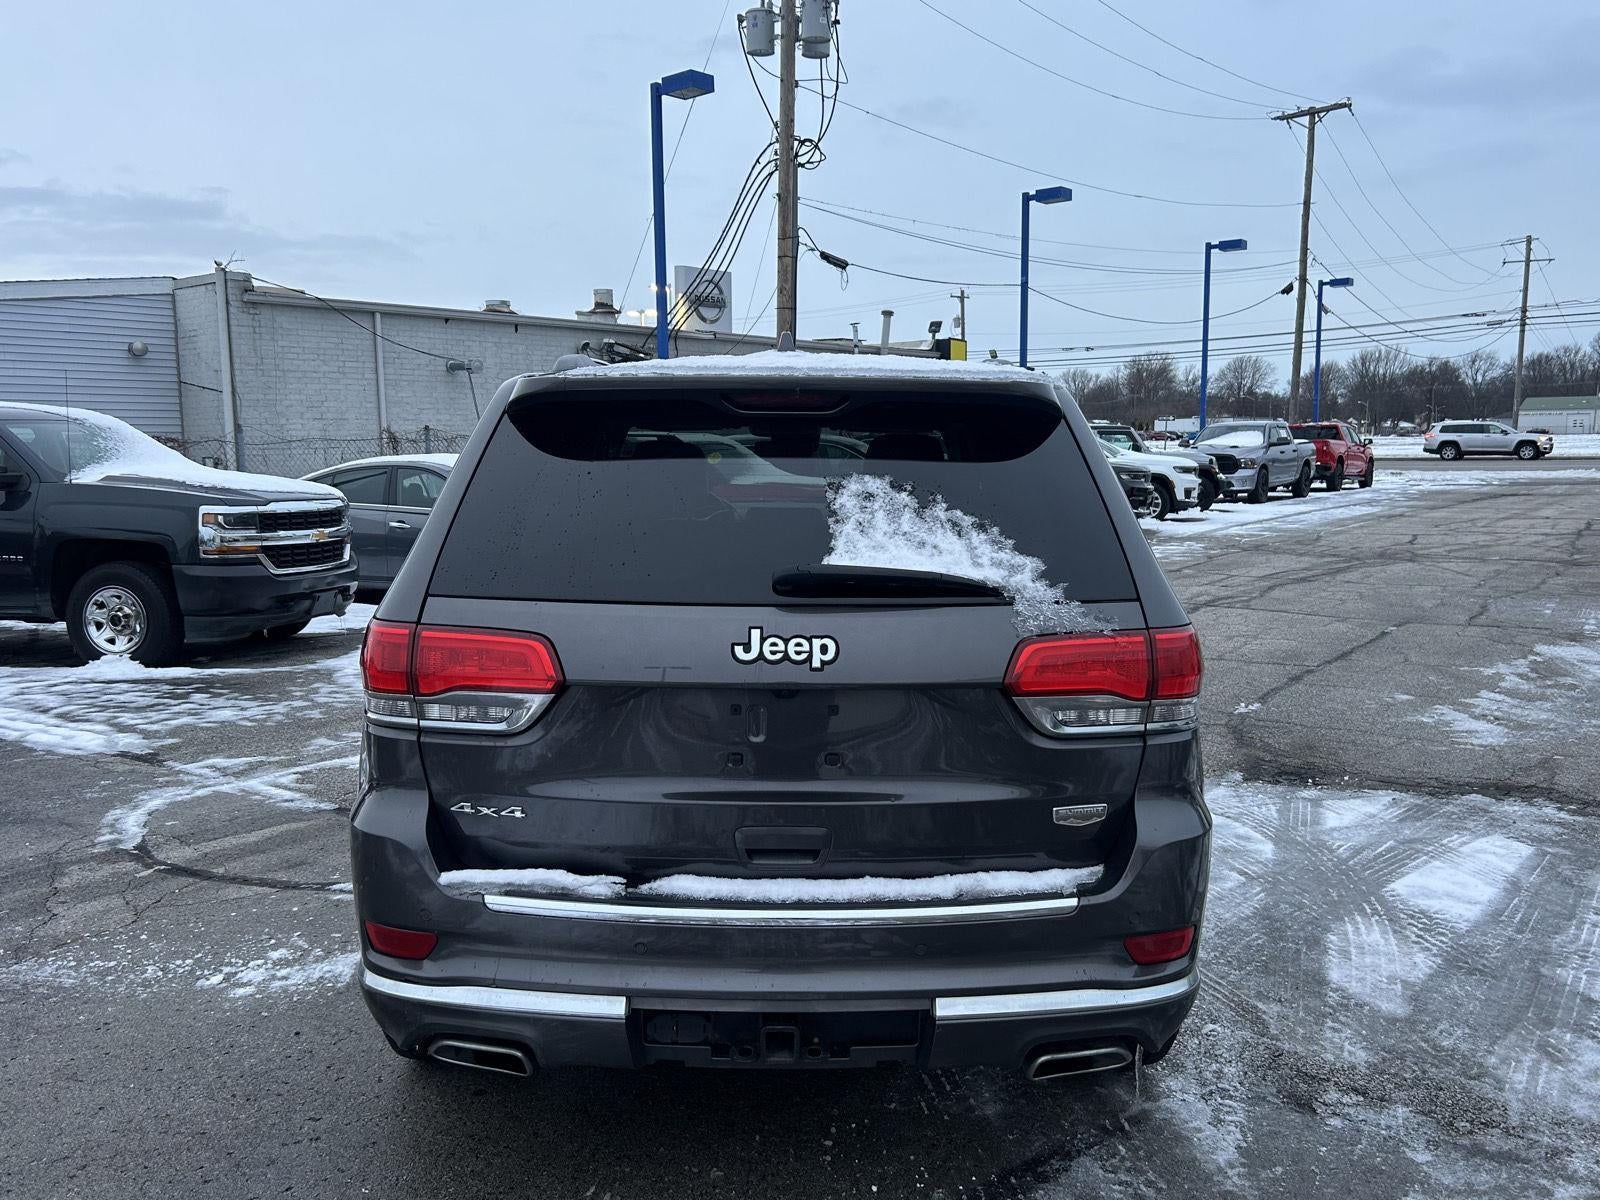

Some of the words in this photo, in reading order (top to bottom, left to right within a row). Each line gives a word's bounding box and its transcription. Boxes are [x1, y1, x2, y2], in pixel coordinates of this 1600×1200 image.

[694, 294, 727, 305] NISSAN
[732, 627, 838, 670] Jeep
[450, 802, 526, 818] 4x4
